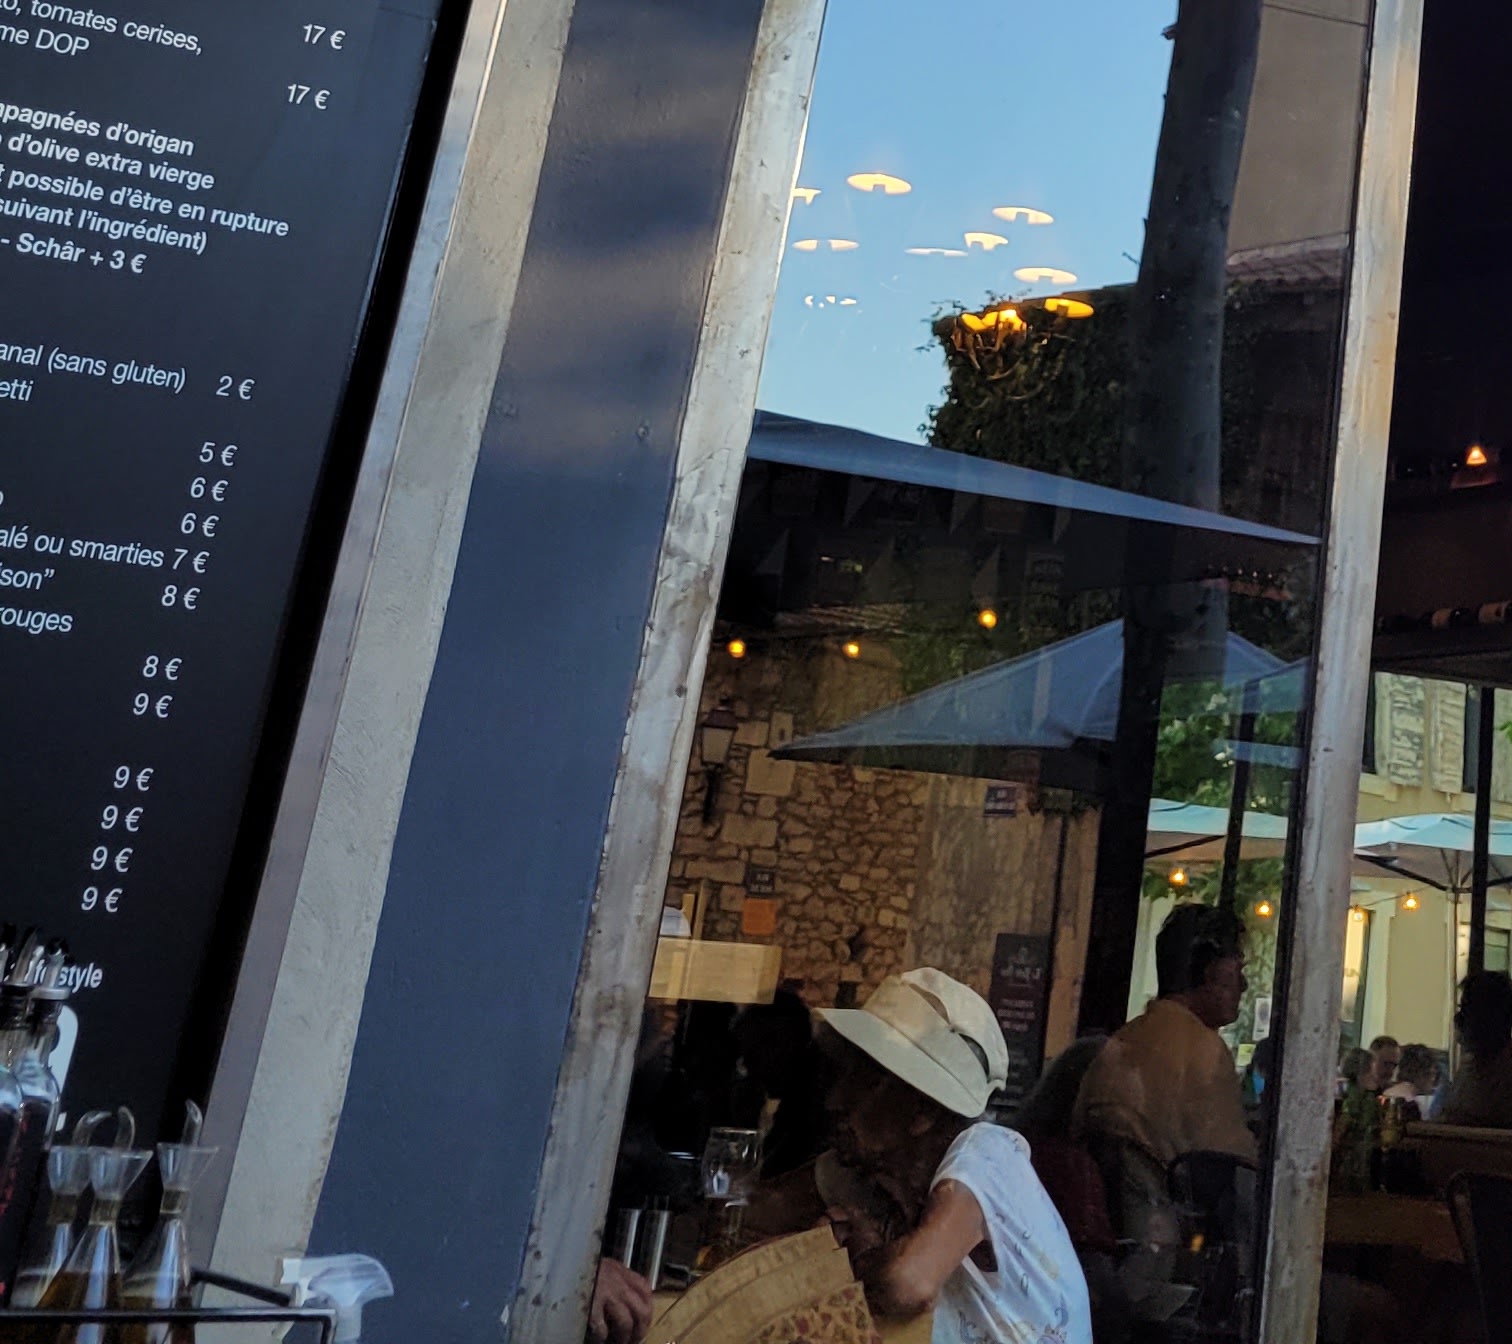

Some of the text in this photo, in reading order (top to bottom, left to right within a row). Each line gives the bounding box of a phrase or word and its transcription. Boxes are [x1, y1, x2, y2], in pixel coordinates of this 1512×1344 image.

[121, 20, 203, 57] cerises,
[286, 82, 332, 111] 17 €
[0, 101, 102, 138] pagnées
[84, 150, 144, 177] extra
[148, 159, 216, 192] vierge
[6, 168, 105, 202] possible
[177, 201, 207, 223] en
[209, 207, 290, 238] rupture
[15, 231, 148, 275] Schâr + 3 €
[46, 345, 108, 378] (sans
[110, 358, 187, 396] gluten)
[214, 374, 234, 398] 2
[237, 377, 256, 402] €
[198, 440, 239, 468] 5 €
[33, 533, 66, 556] ou
[68, 538, 166, 569] smarties
[171, 546, 190, 572] 7
[191, 549, 211, 575] €
[160, 583, 202, 611] 8 €
[131, 691, 174, 720] 9 €
[113, 765, 154, 792] 9 €
[81, 886, 123, 913] 9 €
